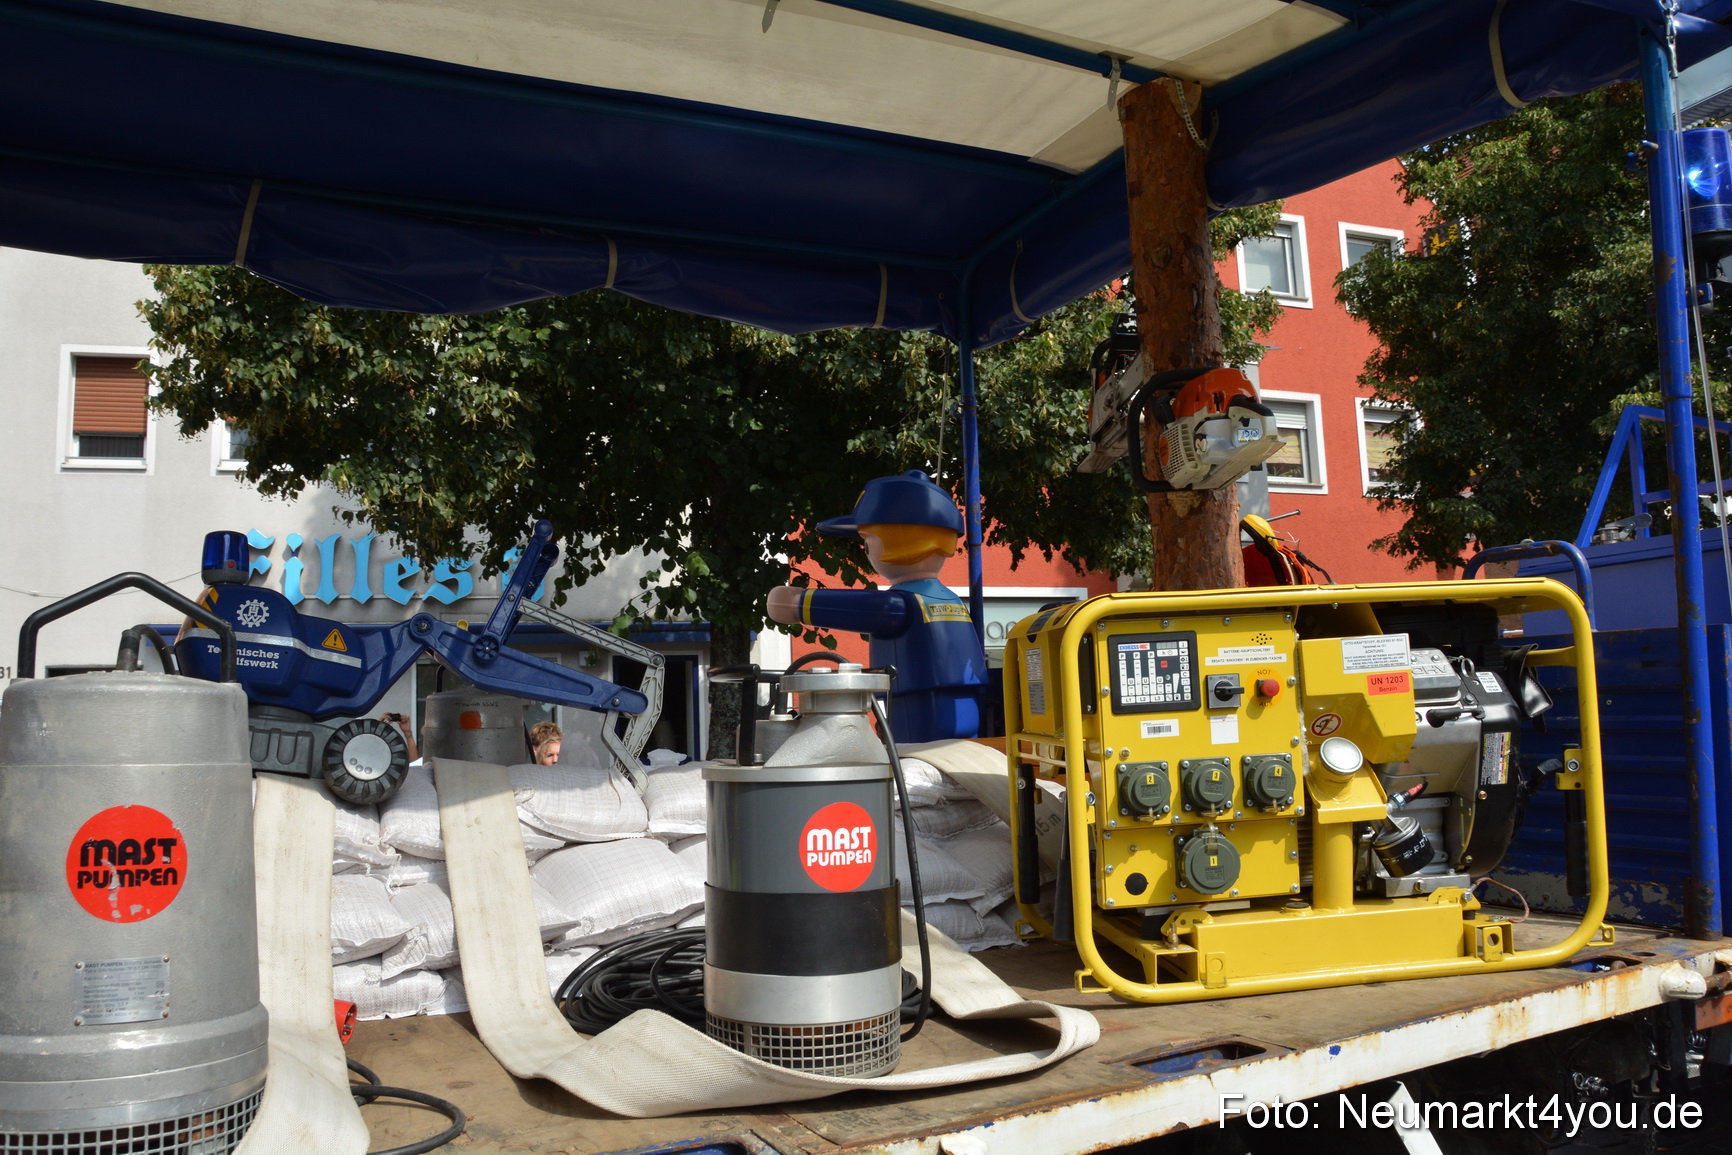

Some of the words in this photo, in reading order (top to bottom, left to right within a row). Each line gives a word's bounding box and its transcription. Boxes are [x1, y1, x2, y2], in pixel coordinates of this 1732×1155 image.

[207, 644, 280, 660] Tenisches
[236, 657, 279, 670] lfswerk
[1257, 668, 1271, 676] NOT
[1370, 678, 1383, 686] UN
[1386, 675, 1404, 684] 1203
[1148, 775, 1153, 783] 2
[1213, 772, 1219, 780] 3
[806, 825, 872, 851] MAST
[79, 838, 178, 867] MAST
[806, 849, 872, 867] PUMPEN
[76, 867, 178, 889] PUMPEN
